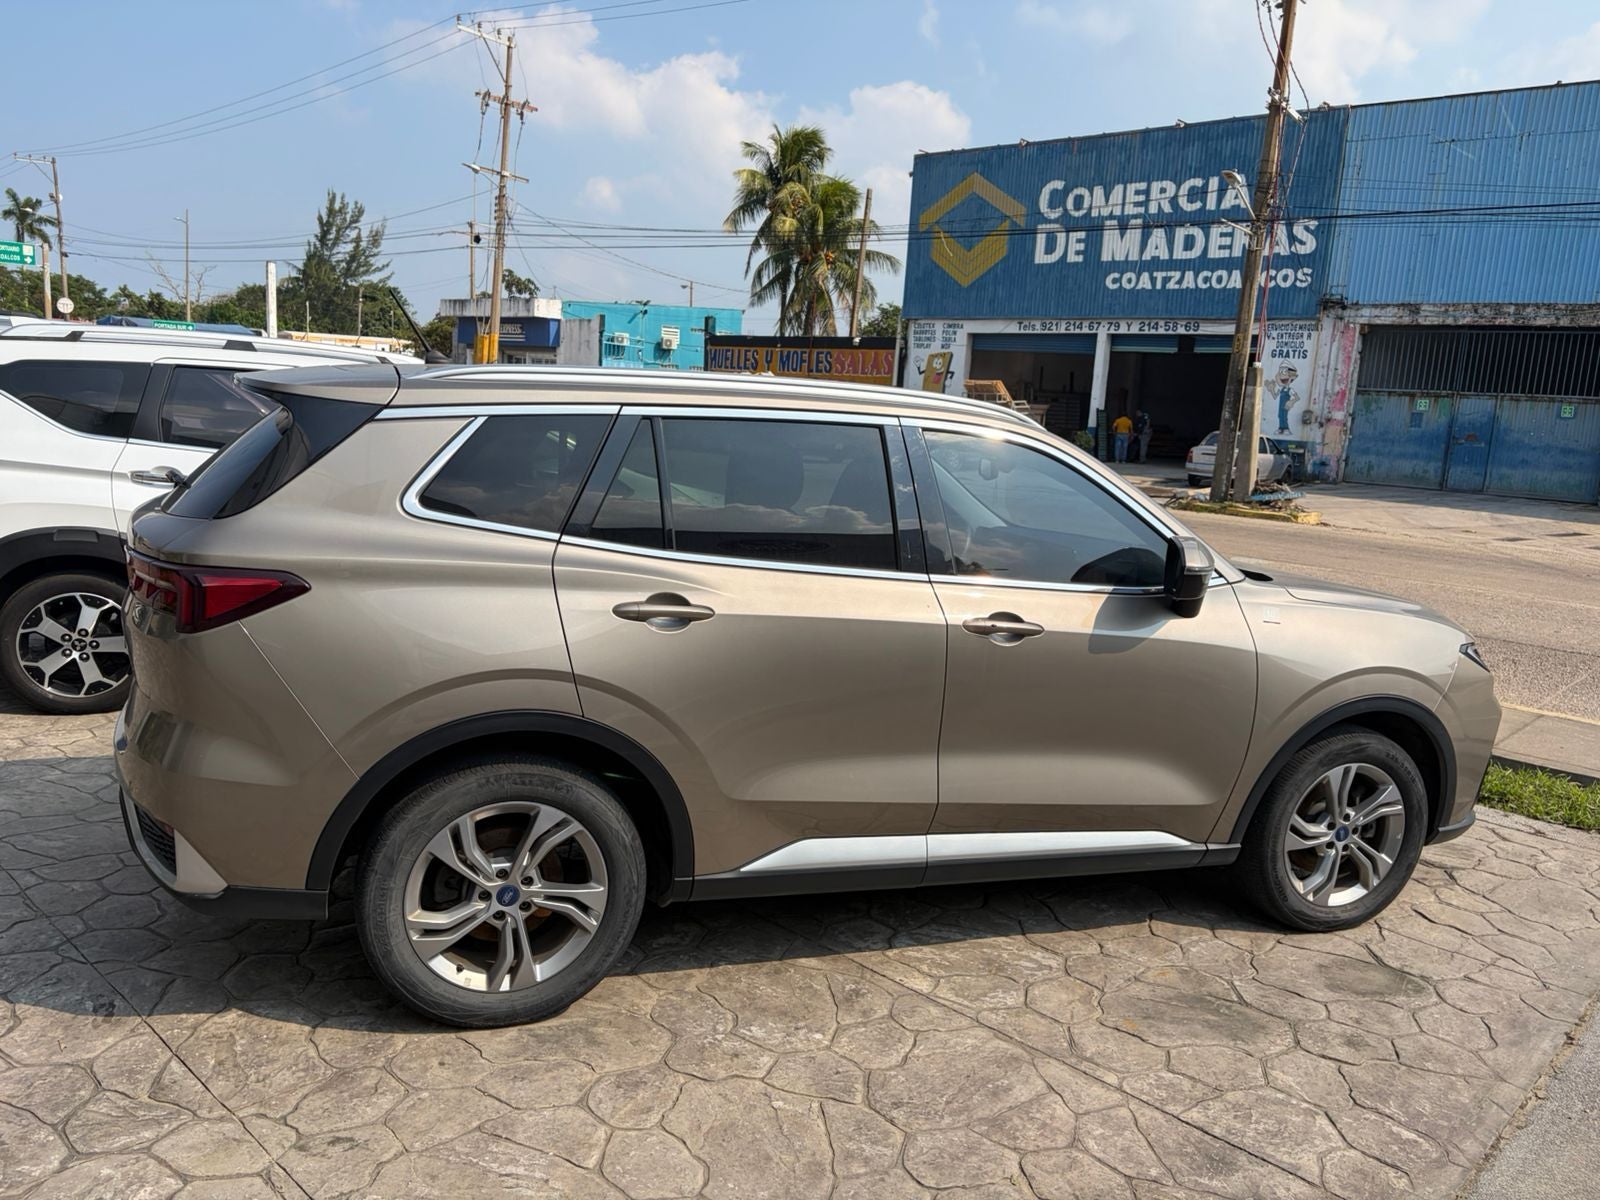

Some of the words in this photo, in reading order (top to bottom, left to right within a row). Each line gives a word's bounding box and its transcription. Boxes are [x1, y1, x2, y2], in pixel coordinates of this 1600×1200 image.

[1038, 174, 1251, 220] COMERCIA
[1105, 267, 1312, 290] COATZACOACOS
[1017, 321, 1039, 332] Tels.
[1064, 320, 1121, 332] 214-67-79
[1126, 321, 1134, 332] Y
[1138, 320, 1200, 332] 214-58-69
[1264, 323, 1289, 332] ERVICIO
[1276, 340, 1305, 349] DOMICILIO
[1271, 349, 1308, 359] GRATIS
[709, 348, 759, 371] MUELLES
[764, 349, 774, 372] Y
[778, 350, 833, 374] MOFLES
[832, 350, 894, 376] SALAS
